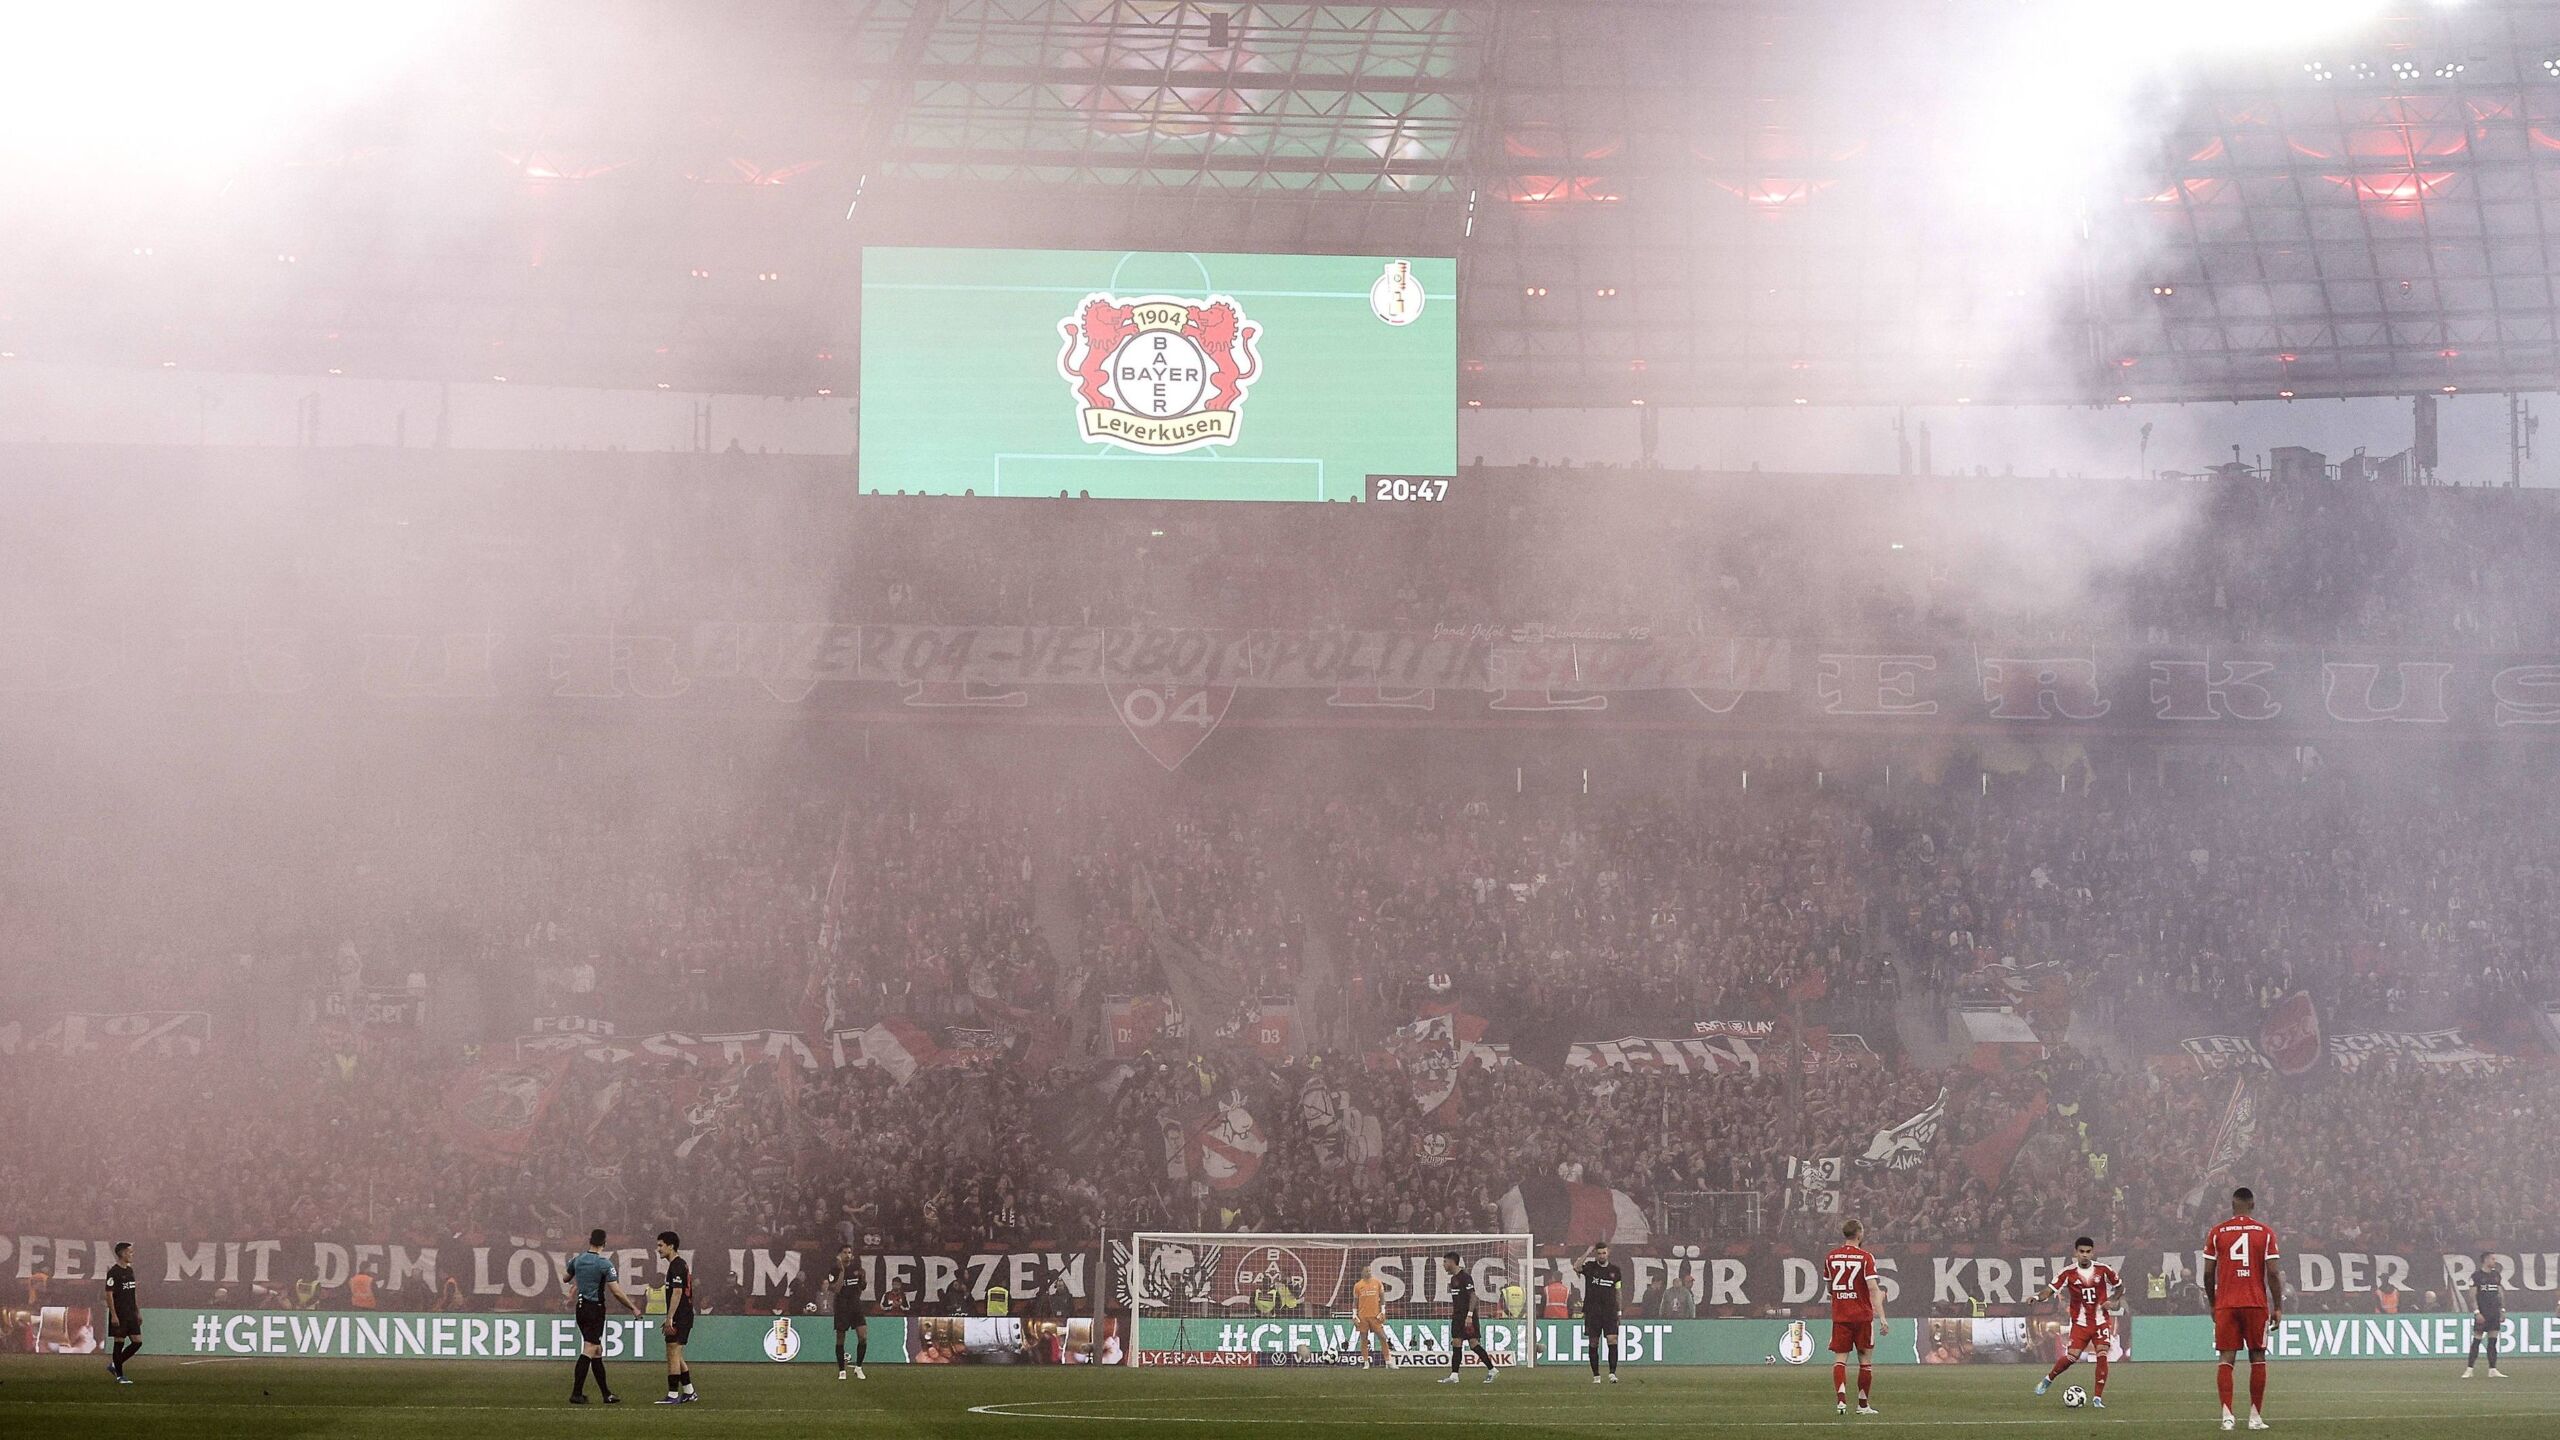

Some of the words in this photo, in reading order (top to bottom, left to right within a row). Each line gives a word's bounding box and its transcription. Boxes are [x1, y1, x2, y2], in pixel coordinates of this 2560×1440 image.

[1137, 309, 1181, 326] 1904
[1122, 367, 1199, 382] BAYER
[1152, 336, 1168, 413] BAYER
[1097, 413, 1222, 441] Leverkusen
[1376, 478, 1449, 502] 20:47
[1123, 688, 1215, 728] 04
[1260, 1028, 1281, 1044] D3
[2229, 1232, 2249, 1267] 4
[163, 1240, 283, 1282] MIT
[314, 1242, 438, 1294] DEM
[729, 1248, 802, 1297] IM
[1239, 1272, 1304, 1288] BAYR
[1630, 1245, 1752, 1305] FÜR
[1782, 1258, 1900, 1304] DS
[2298, 1252, 2415, 1292] DER
[1831, 1260, 1862, 1291] 27
[2236, 1269, 2250, 1277] TAH
[2081, 1286, 2097, 1304] T
[190, 1314, 654, 1361] #GEWINNERBLEBT
[2096, 1327, 2110, 1339] 14
[1394, 1353, 1450, 1366] TARGO
